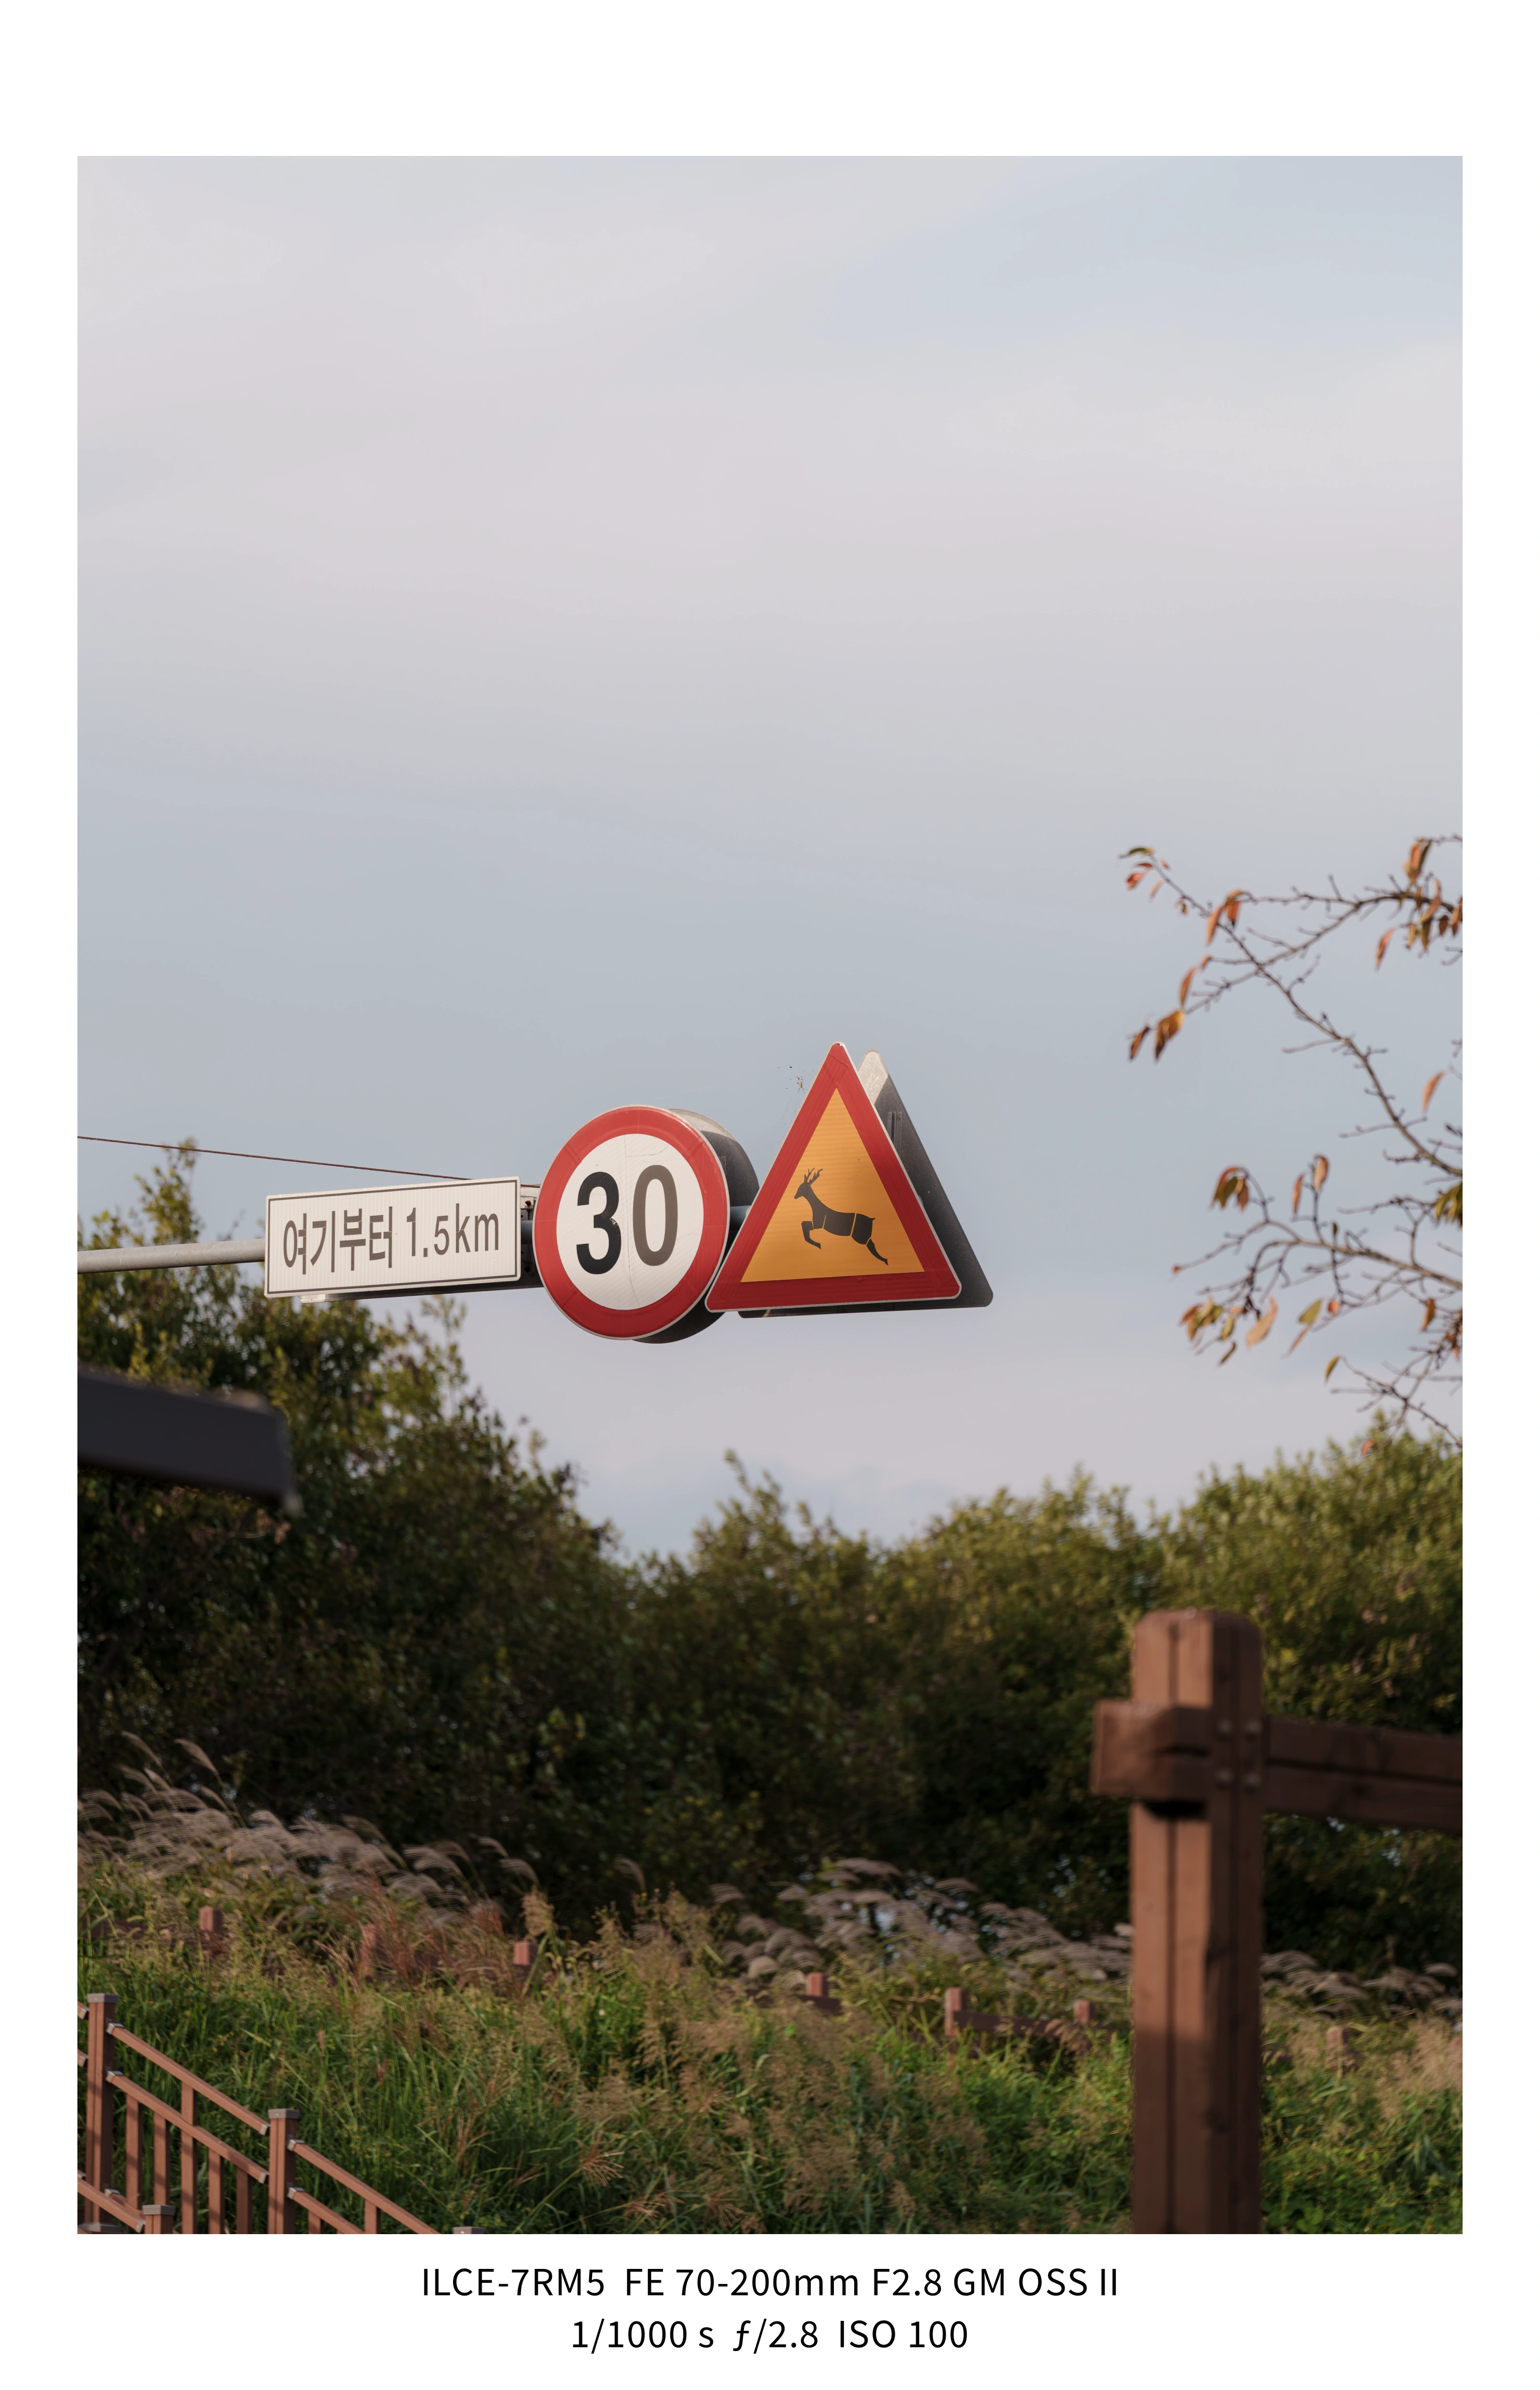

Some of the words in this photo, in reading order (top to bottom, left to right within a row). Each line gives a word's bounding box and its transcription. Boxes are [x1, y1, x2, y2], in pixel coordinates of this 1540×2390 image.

[283, 1206, 393, 1275] 여기부터
[406, 1203, 499, 1257] 1.5km
[576, 1164, 679, 1275] 30
